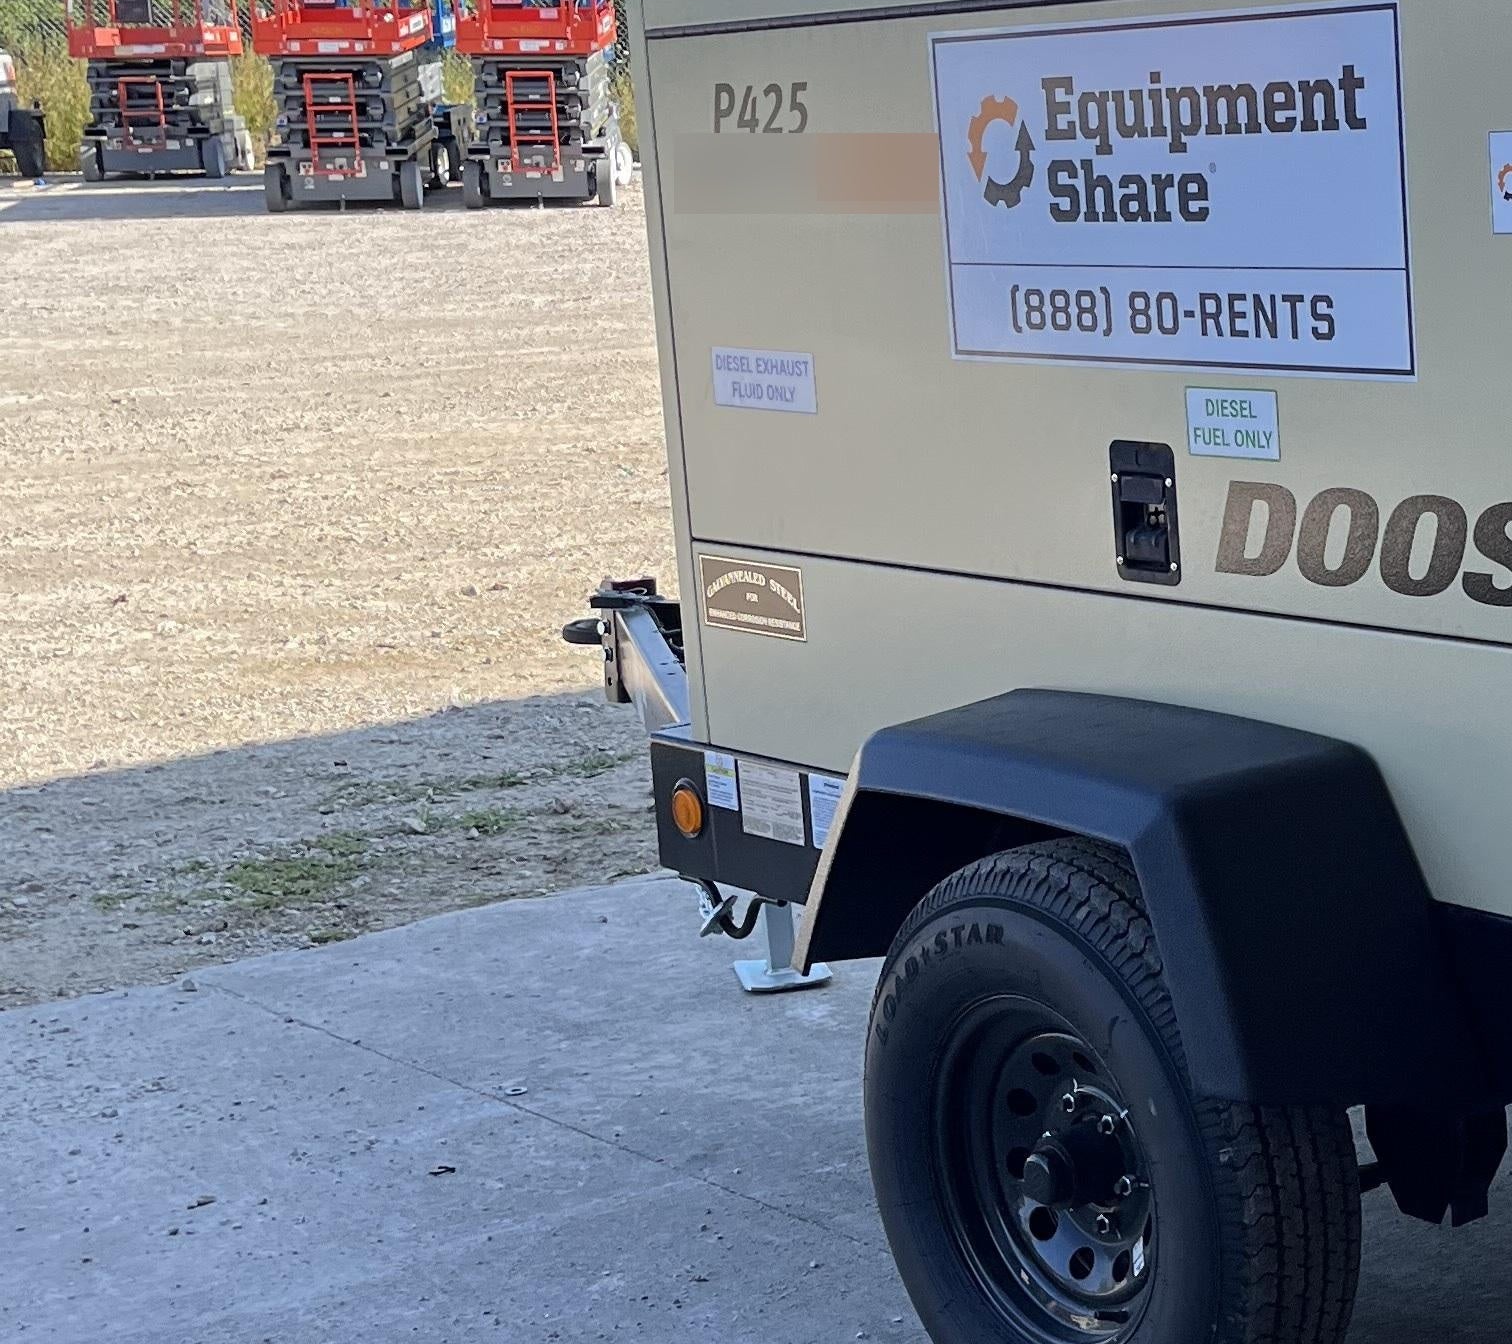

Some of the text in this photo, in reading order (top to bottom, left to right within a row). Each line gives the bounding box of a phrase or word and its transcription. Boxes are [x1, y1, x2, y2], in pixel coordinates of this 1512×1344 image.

[713, 81, 808, 134] P425
[1041, 64, 1367, 155] Equipment
[1047, 159, 1210, 222] Share
[1010, 284, 1336, 341] (888) 80-RENTS
[715, 354, 809, 377] DIESEL EXHAUST
[731, 380, 796, 403] FLUID ONLY
[1205, 398, 1258, 419] DIESEL
[1193, 427, 1272, 449] FUEL ONLY
[769, 579, 801, 614] STEEL
